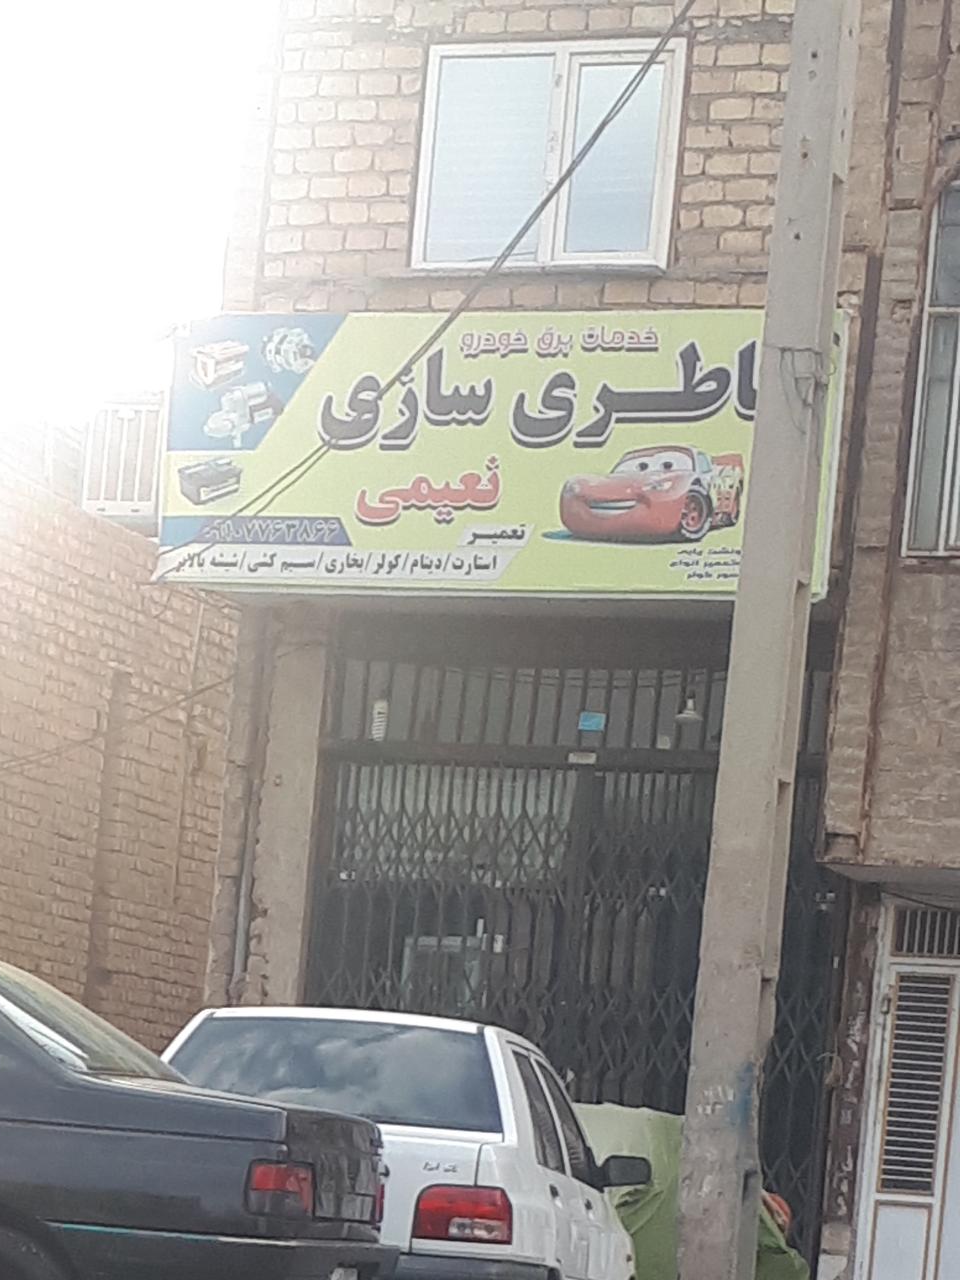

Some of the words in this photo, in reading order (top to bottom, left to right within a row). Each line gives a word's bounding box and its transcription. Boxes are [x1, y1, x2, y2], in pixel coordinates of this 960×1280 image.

[461, 328, 528, 358] خودرو
[536, 326, 572, 357] برق
[581, 326, 660, 352] خدمات
[318, 348, 493, 450] سازی
[510, 340, 758, 448] اطری
[355, 456, 501, 525] نعیمی
[467, 525, 526, 544] تعمیر
